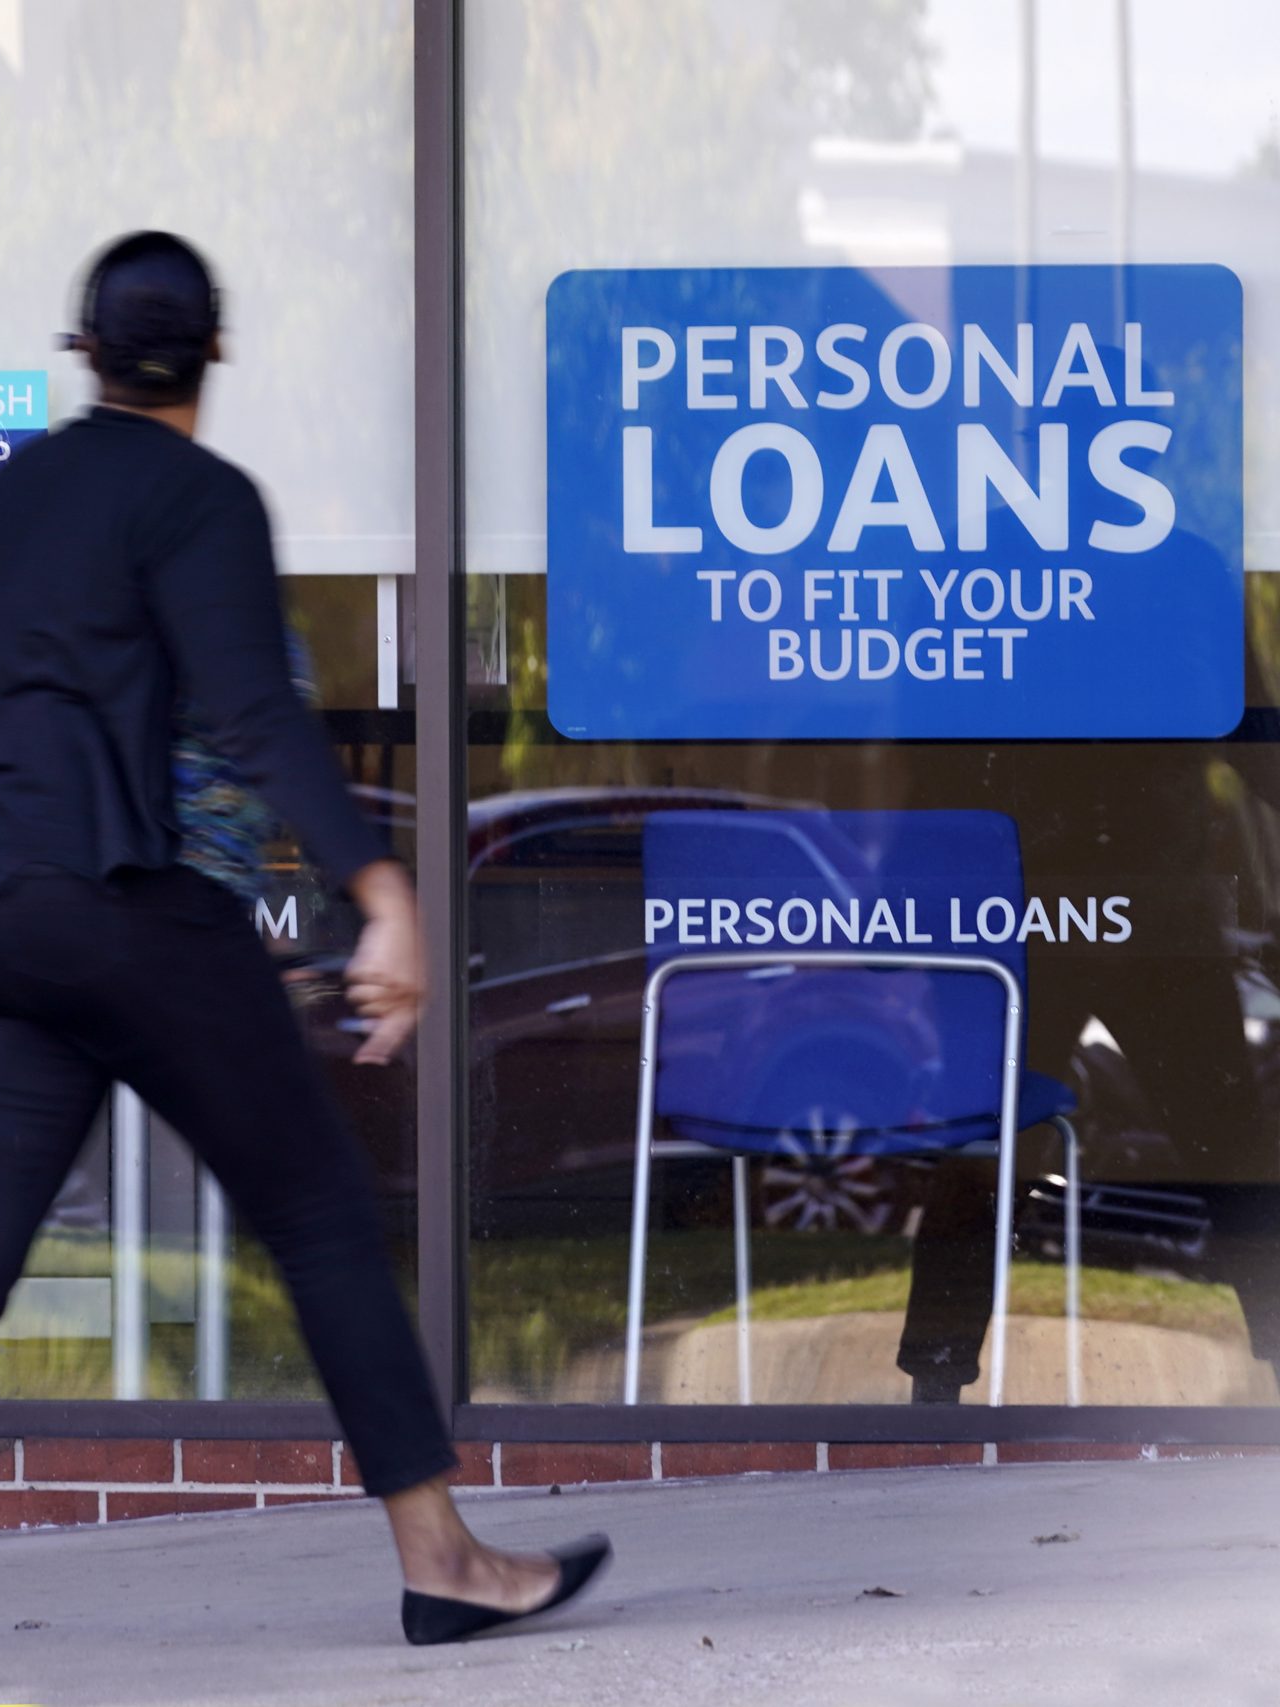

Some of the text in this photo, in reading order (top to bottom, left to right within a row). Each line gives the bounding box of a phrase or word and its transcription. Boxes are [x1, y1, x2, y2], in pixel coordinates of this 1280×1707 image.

[621, 322, 1175, 411] PERSONAL
[622, 419, 1176, 555] LOANS
[696, 568, 1095, 623] TO FIT YOUR
[768, 627, 1028, 681] BUDGET
[644, 896, 1132, 945] PERSONAL LOANS
